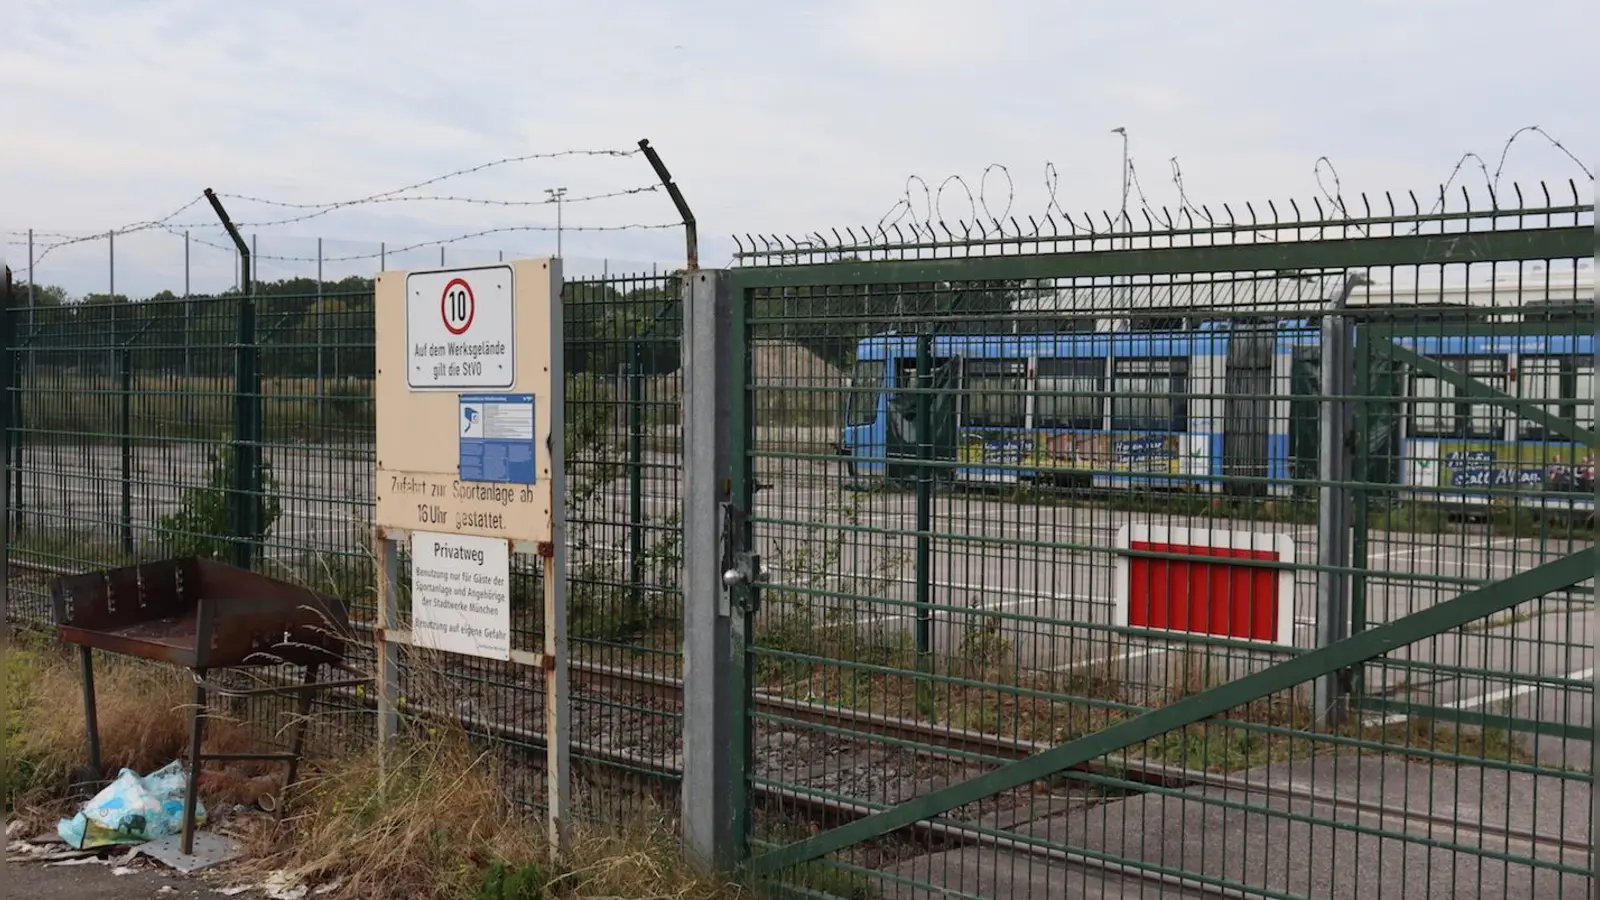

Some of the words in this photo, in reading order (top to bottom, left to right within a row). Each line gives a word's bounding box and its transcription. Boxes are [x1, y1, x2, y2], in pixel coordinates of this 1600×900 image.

[449, 290, 466, 322] 10
[414, 343, 427, 358] Auf
[430, 342, 446, 356] dem
[448, 341, 505, 359] Werksgelände
[433, 363, 446, 380] gilt
[448, 363, 460, 376] die
[462, 362, 482, 376] StVO
[391, 476, 426, 496] Zufahrt
[431, 484, 448, 498] zur
[452, 480, 514, 506] Sportanlage
[520, 484, 534, 504] ab
[418, 504, 428, 523] 16
[430, 506, 448, 525] Uhr
[434, 542, 484, 566] Privatweg
[416, 567, 448, 582] Benutzung
[450, 572, 460, 581] nur
[462, 572, 472, 582] für
[474, 572, 492, 585] Gäste
[493, 575, 504, 586] der
[416, 581, 452, 596] Sportanlage
[454, 586, 466, 598] und
[468, 588, 505, 602] Angehörige
[422, 596, 432, 606] der
[434, 598, 468, 612] Stadtwerke
[469, 602, 499, 616] München
[415, 618, 448, 634] Benutzung
[449, 623, 460, 634] auf
[461, 625, 482, 638] eigene
[484, 628, 507, 641] Gefahr
